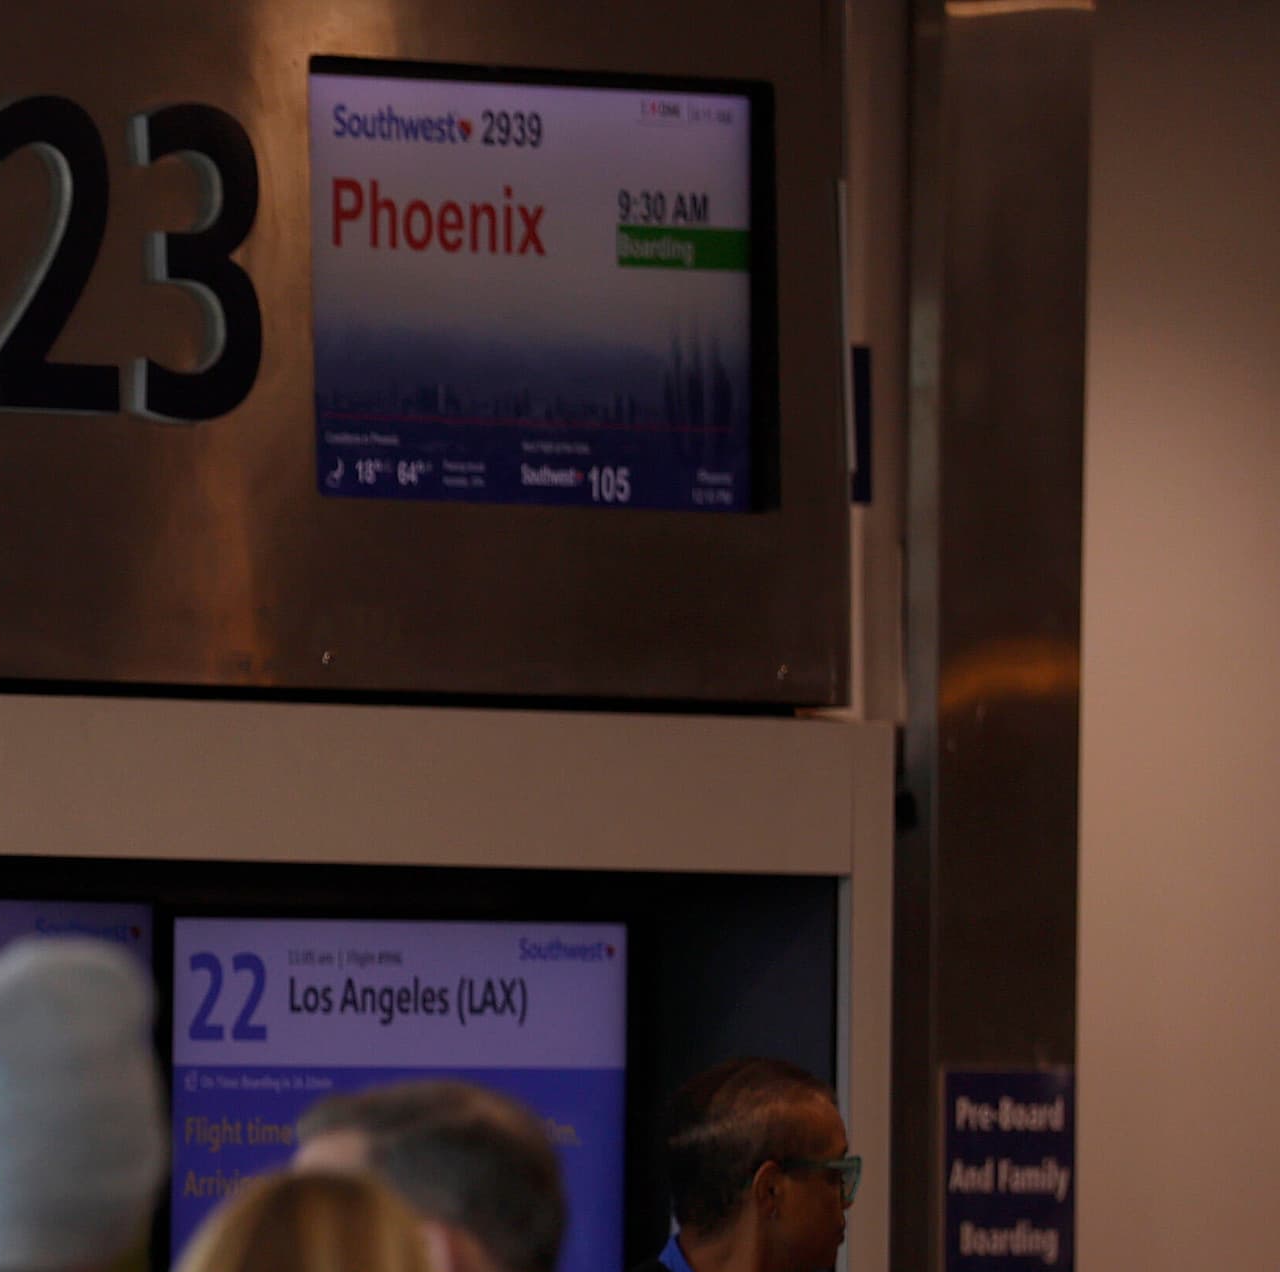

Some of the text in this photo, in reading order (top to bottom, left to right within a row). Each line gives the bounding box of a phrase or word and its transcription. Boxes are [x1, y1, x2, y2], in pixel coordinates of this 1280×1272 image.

[333, 105, 542, 147] Southwest 2939
[331, 178, 546, 256] Phoenix
[618, 190, 709, 222] 9:30 AM
[589, 466, 631, 501] 105
[518, 938, 604, 963] Southwest
[188, 952, 268, 1042] 22
[289, 978, 528, 1025] Los Angeles (LAX)
[955, 1096, 1065, 1131] Pre-Board
[184, 1118, 242, 1152] Flight
[950, 1157, 1069, 1202] And Family
[960, 1220, 1059, 1264] Boarding
